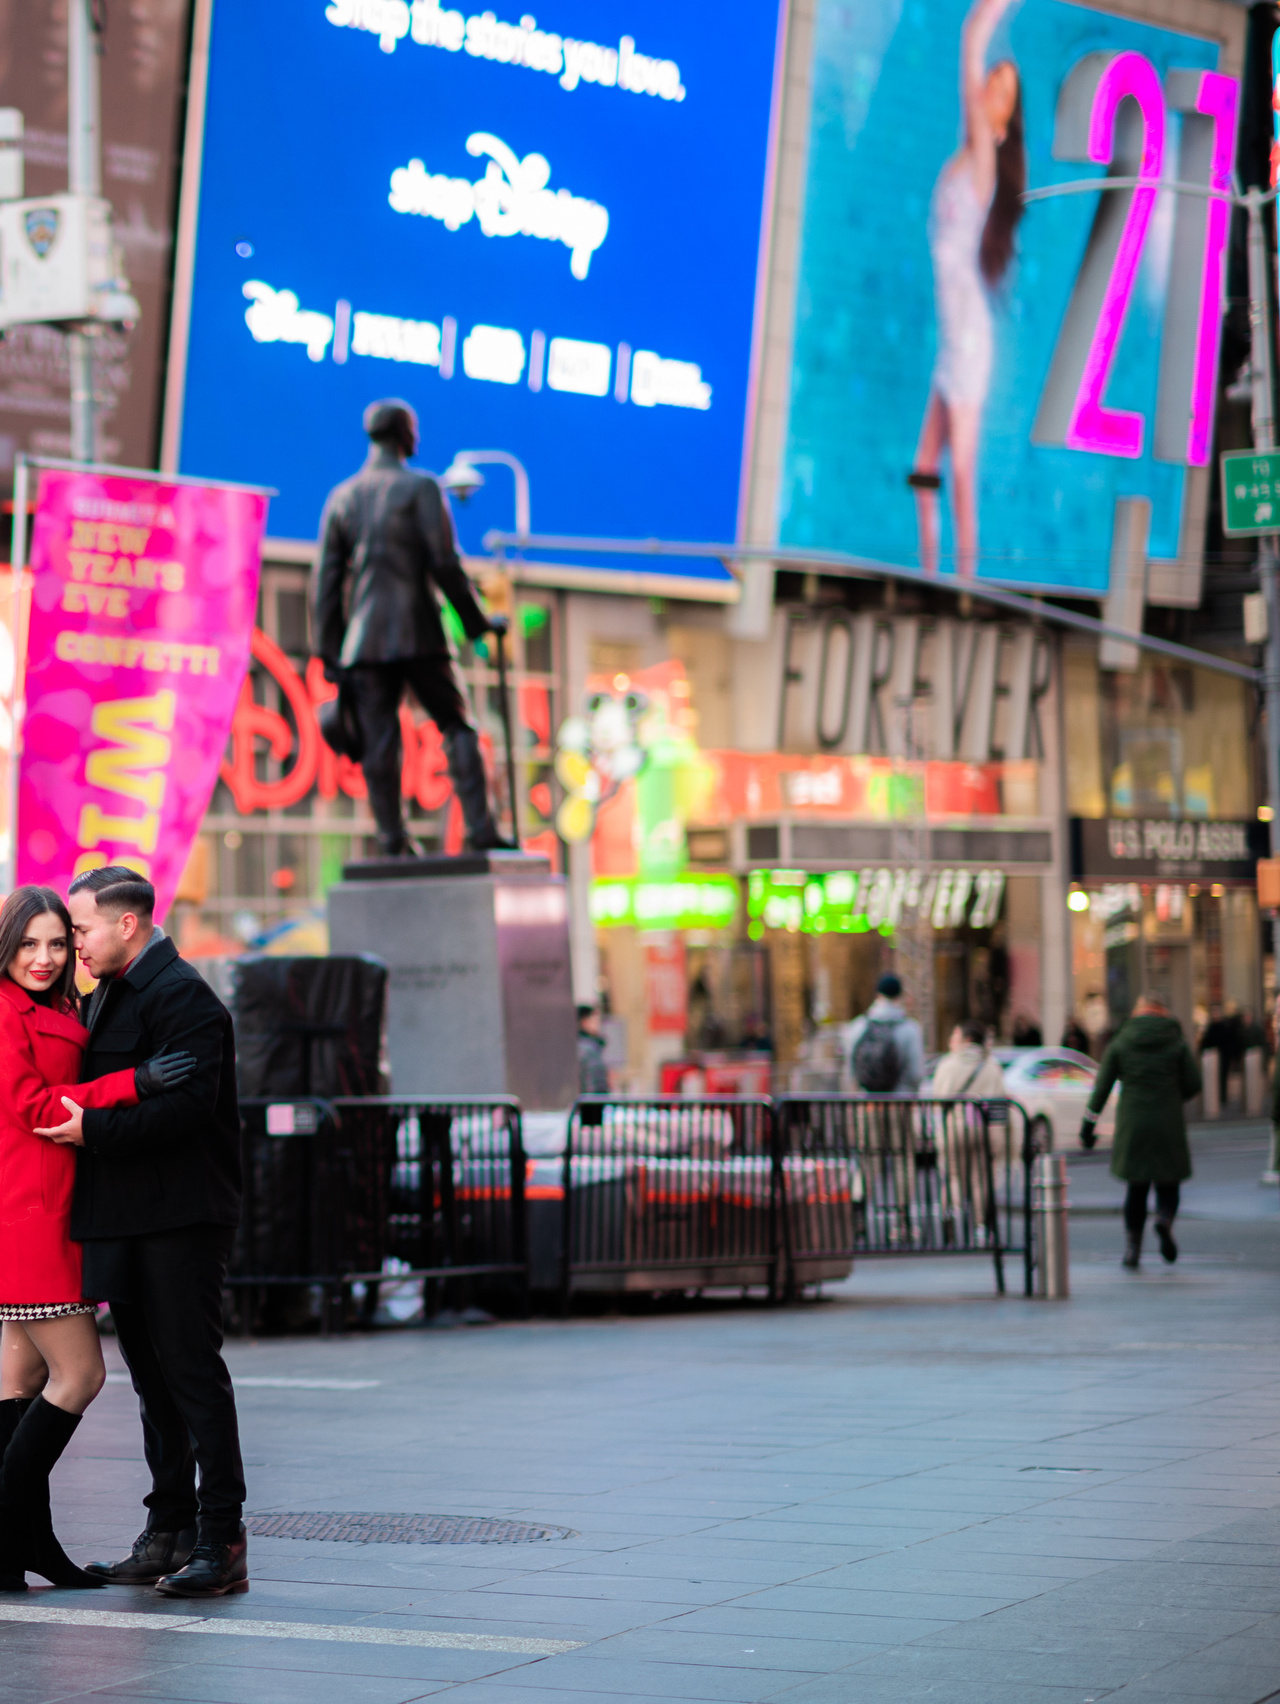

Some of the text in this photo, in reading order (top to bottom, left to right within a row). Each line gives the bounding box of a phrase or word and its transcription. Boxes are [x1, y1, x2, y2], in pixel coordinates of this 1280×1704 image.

[411, 0, 465, 52] the
[464, 11, 563, 75] stories
[559, 38, 619, 91] you
[71, 519, 152, 555] NEW
[67, 550, 185, 593] YEAR'S
[63, 582, 131, 618] EVE
[55, 630, 219, 677] CONFETTI
[772, 606, 1052, 764] FOREVER
[1144, 820, 1194, 860] POLO
